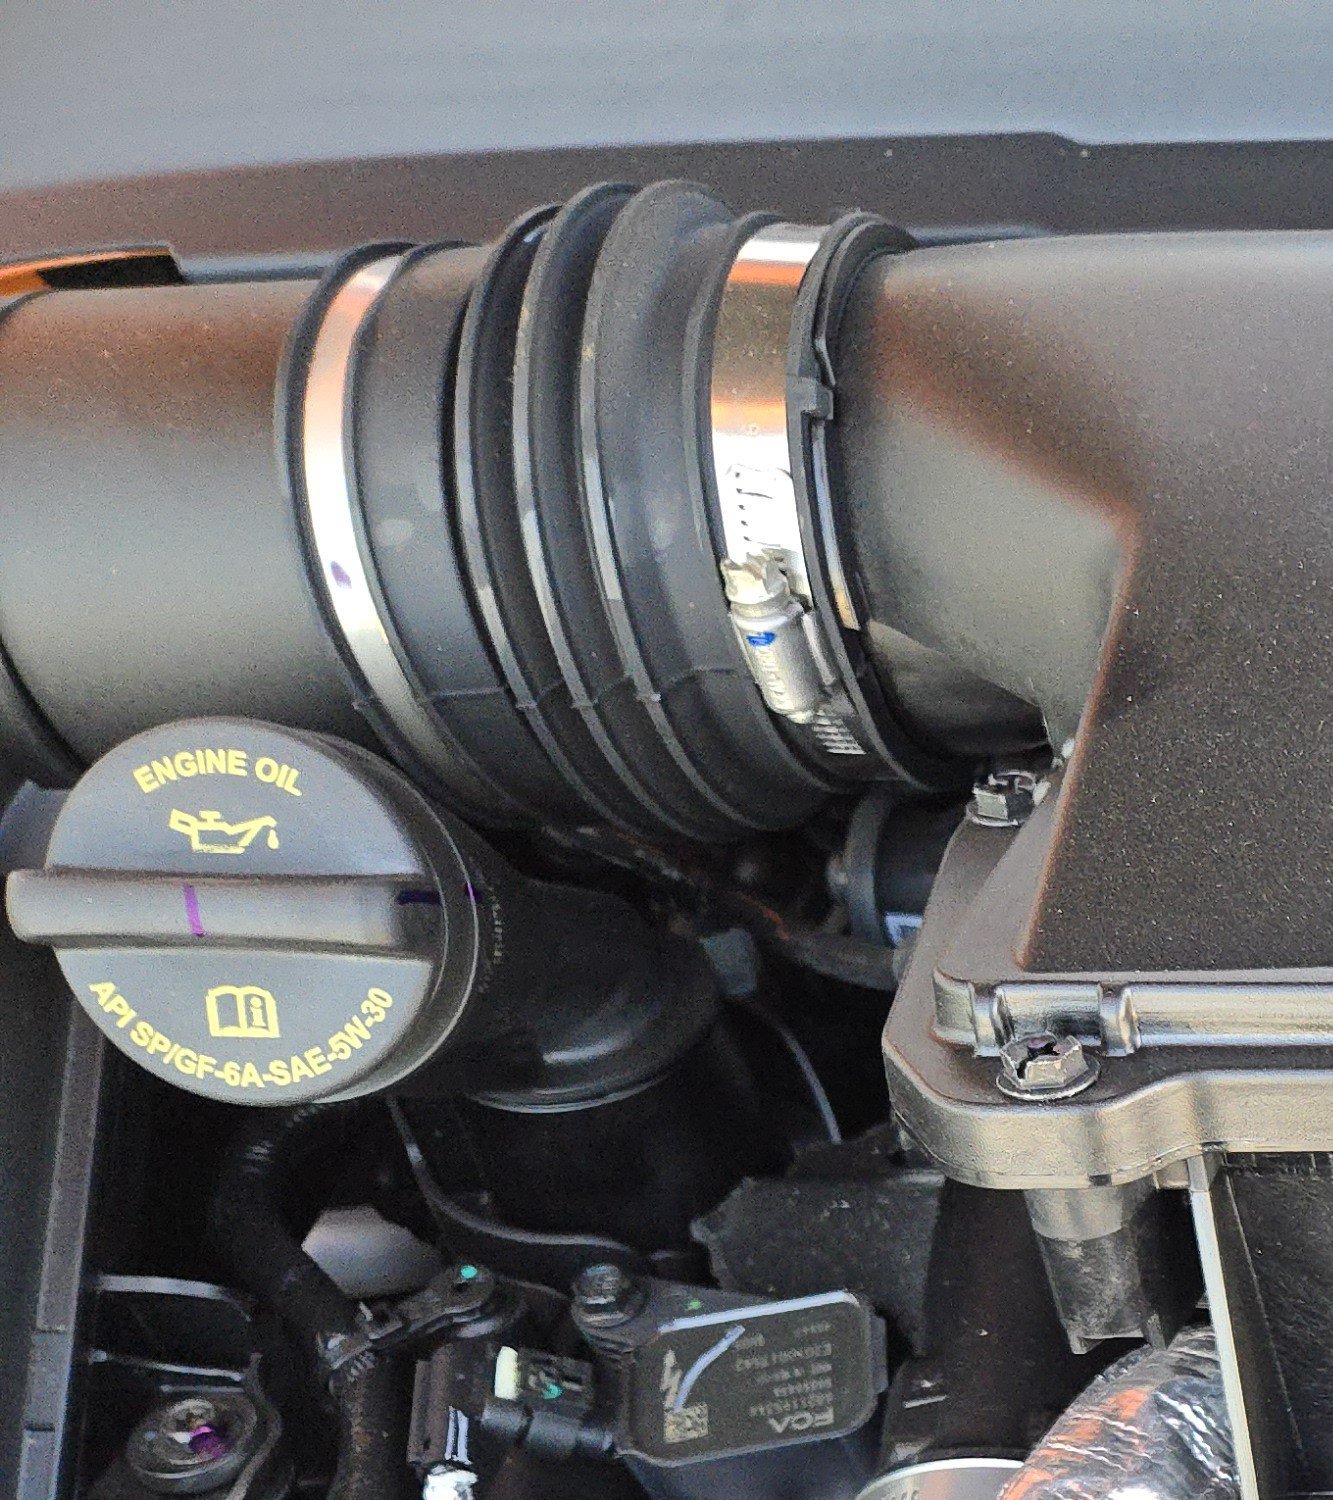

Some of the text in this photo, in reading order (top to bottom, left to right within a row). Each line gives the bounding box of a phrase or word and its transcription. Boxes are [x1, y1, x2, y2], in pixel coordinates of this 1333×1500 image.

[133, 749, 302, 796] ENGINE OIL
[89, 980, 138, 1028] API
[769, 1407, 834, 1433] FCA
